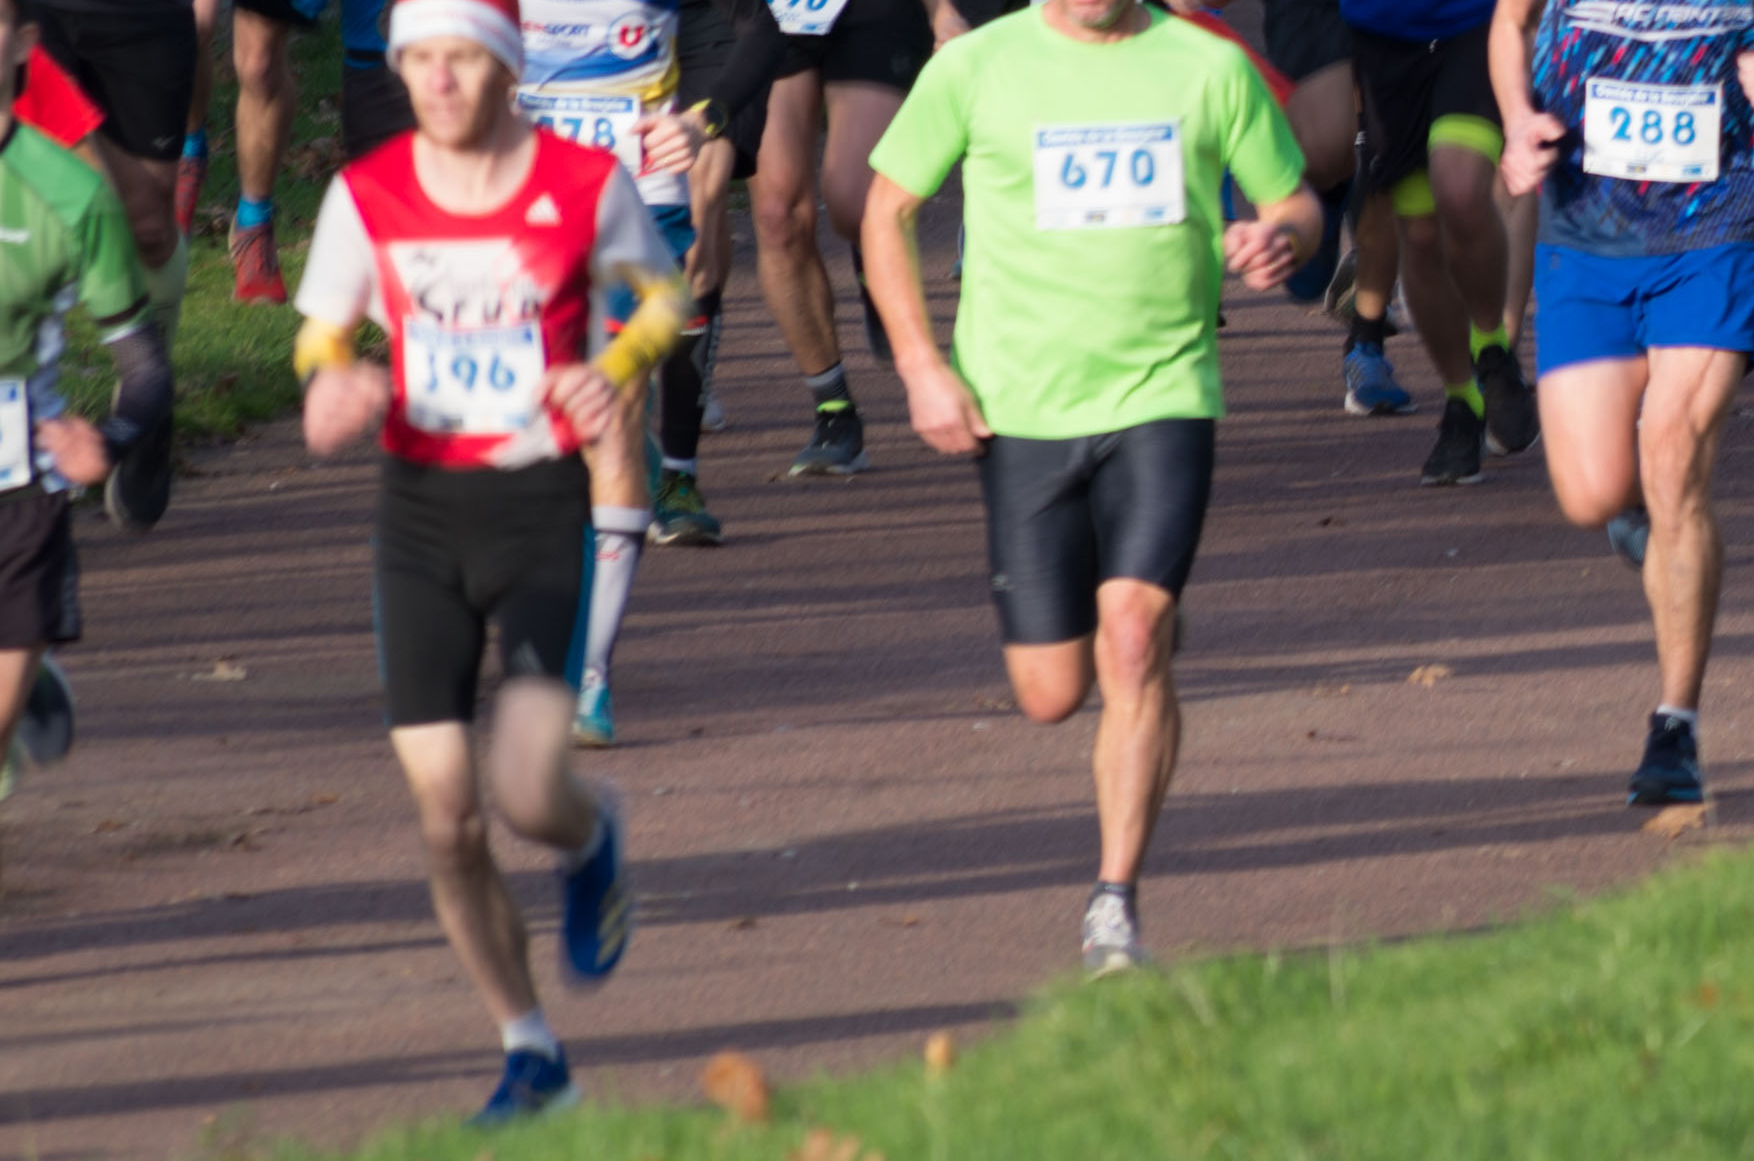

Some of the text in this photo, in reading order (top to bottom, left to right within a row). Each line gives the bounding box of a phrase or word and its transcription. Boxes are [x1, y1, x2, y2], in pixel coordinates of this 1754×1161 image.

[535, 116, 617, 150] 78
[1609, 106, 1696, 145] 288
[1060, 149, 1155, 189] 670
